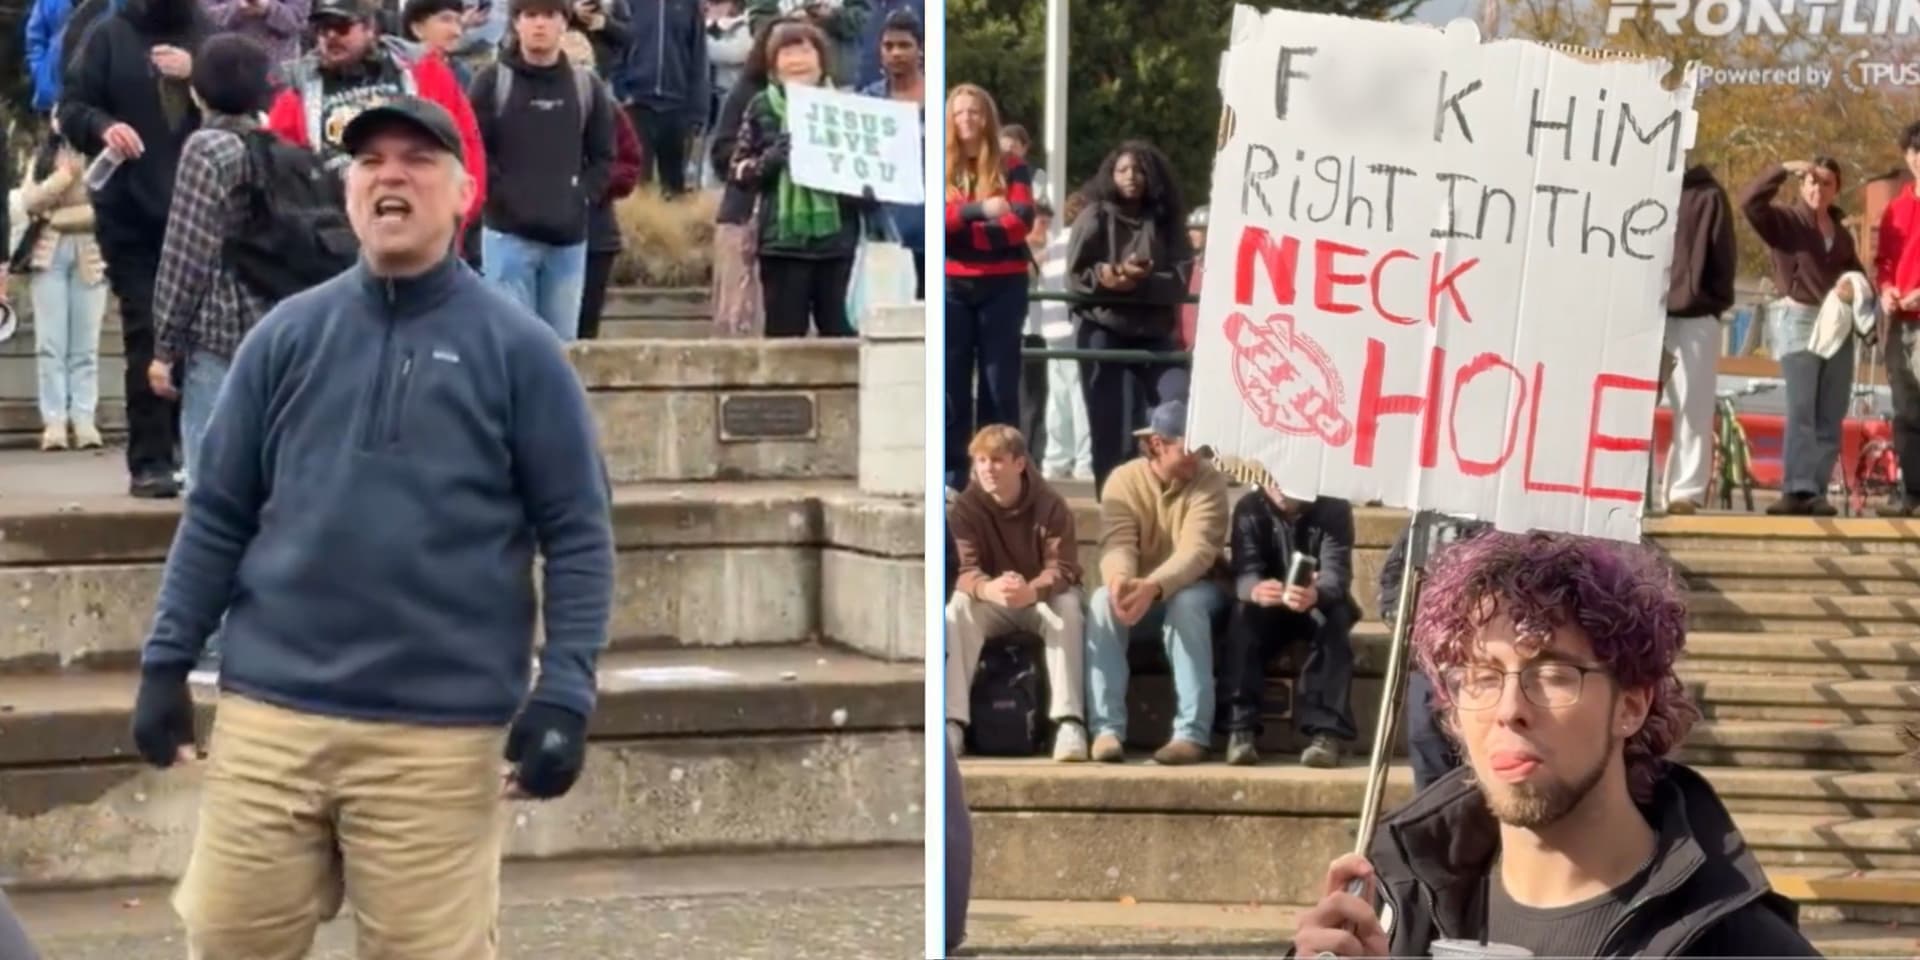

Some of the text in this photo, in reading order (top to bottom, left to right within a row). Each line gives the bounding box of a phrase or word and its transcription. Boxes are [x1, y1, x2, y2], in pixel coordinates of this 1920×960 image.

[805, 102, 897, 137] JESUS
[1275, 45, 1484, 144] FK
[827, 151, 897, 183] YOU
[1430, 171, 1517, 244] In
[1535, 184, 1669, 261] The
[1234, 225, 1480, 328] NECK
[1352, 336, 1662, 503] HOLE
